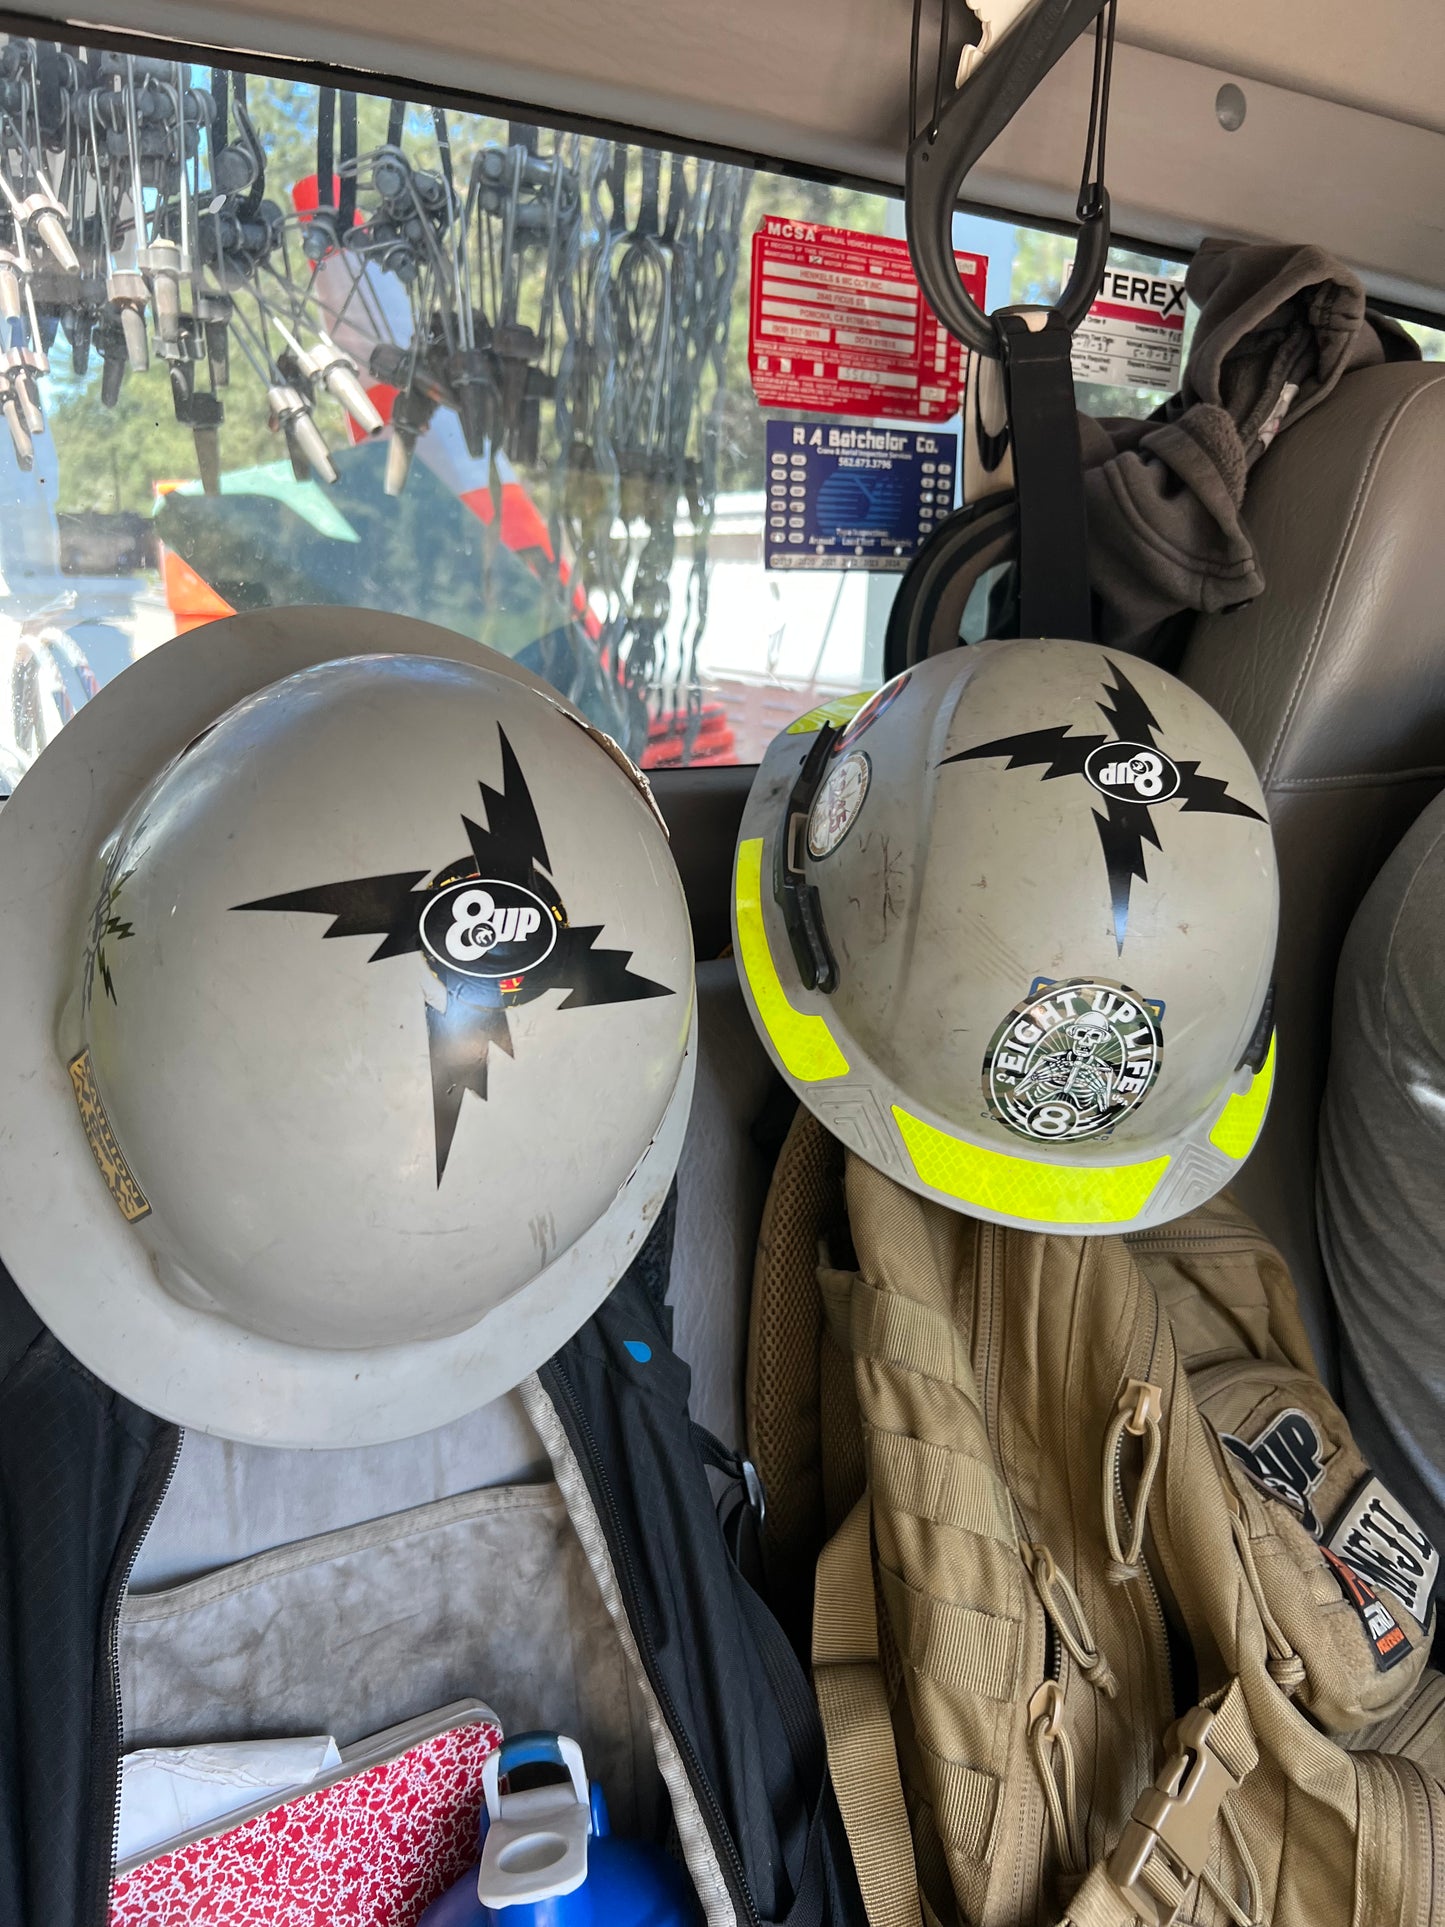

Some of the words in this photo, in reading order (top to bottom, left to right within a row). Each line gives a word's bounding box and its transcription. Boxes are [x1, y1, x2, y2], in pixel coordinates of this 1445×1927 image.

[768, 221, 816, 242] MCSA
[1099, 272, 1185, 316] TEREX
[793, 428, 805, 444] R
[809, 429, 822, 445] A
[829, 429, 908, 451] Batchelor
[916, 437, 938, 453] Co.
[997, 991, 1078, 1073] EIGHT
[1091, 990, 1138, 1024] UP
[1117, 1026, 1152, 1095] LIFE
[996, 1073, 1016, 1086] CA
[1111, 1094, 1129, 1106] USA
[1031, 1106, 1071, 1134] 8
